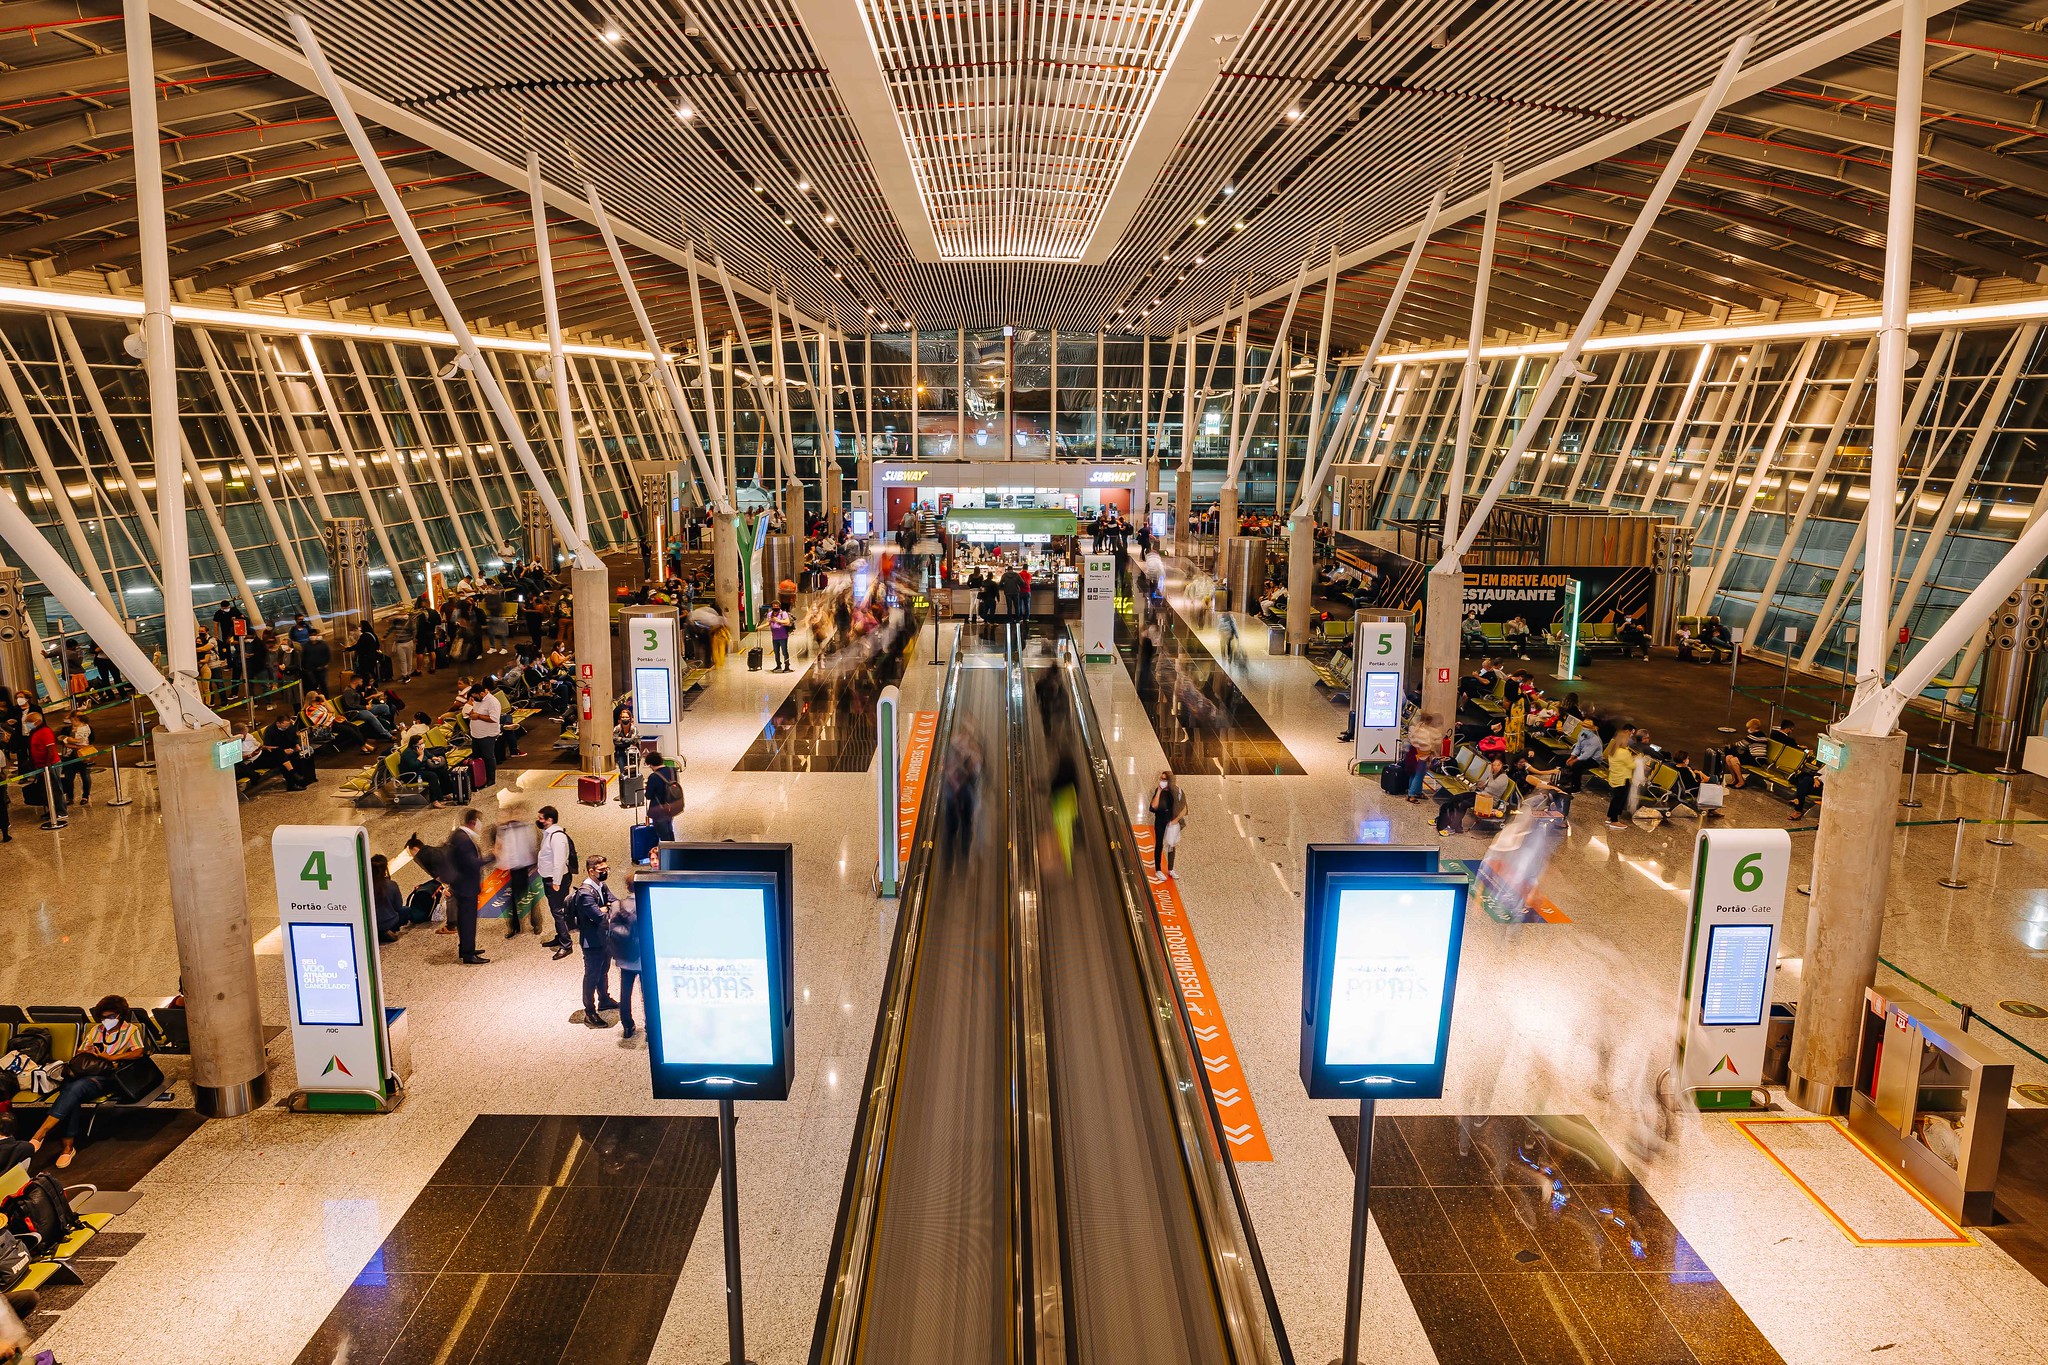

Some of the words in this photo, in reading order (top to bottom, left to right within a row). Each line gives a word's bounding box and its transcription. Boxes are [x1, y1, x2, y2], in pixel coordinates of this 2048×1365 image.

[881, 470, 929, 482] SUBWAY
[1089, 470, 1137, 483] SUBWAY
[857, 495, 863, 504] 1
[1156, 496, 1163, 506] 2
[1481, 573, 1499, 586] EM
[1500, 574, 1539, 586] BREVE
[1462, 588, 1556, 601] ESTAURANTE
[643, 628, 659, 651] 3
[1376, 633, 1392, 655] 5
[300, 850, 333, 891] 4
[1732, 852, 1764, 893] 6
[291, 902, 322, 911] Portão
[327, 903, 348, 911] Gate
[1152, 889, 1177, 917] Arrivals
[1716, 904, 1747, 913] Portão
[1751, 904, 1771, 913] Gate
[1163, 925, 1205, 998] DESEMBARQUE
